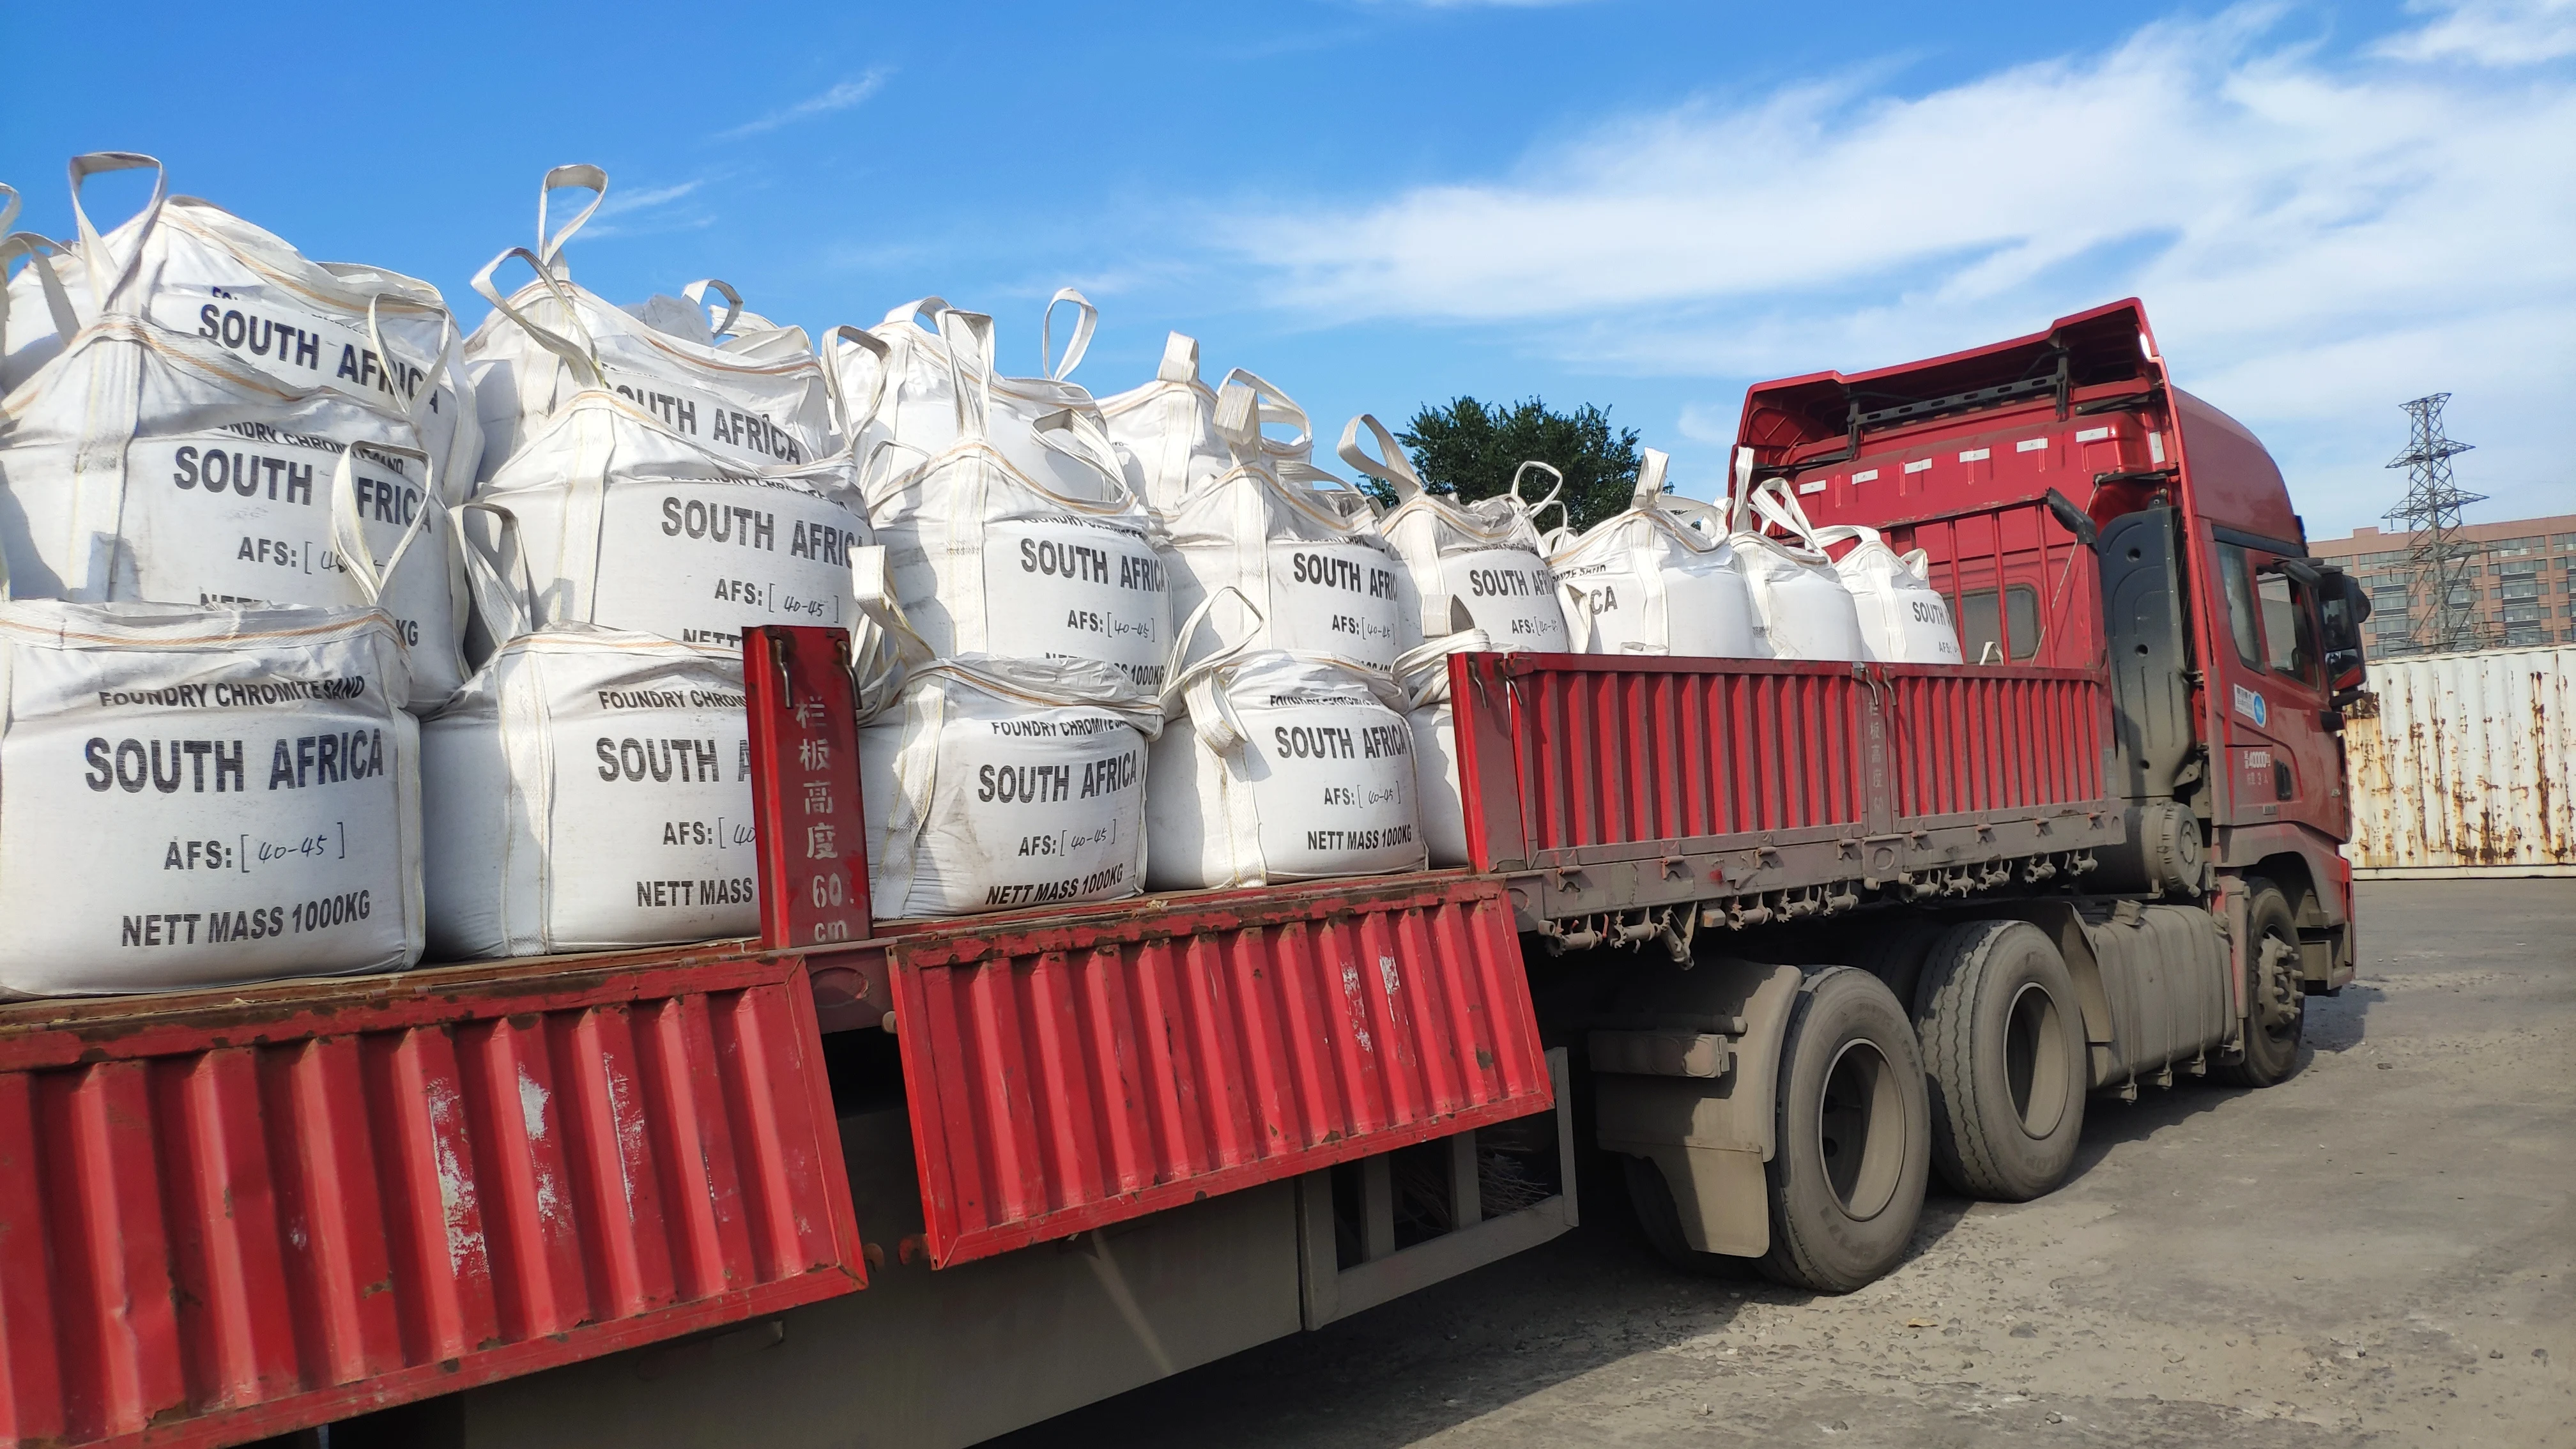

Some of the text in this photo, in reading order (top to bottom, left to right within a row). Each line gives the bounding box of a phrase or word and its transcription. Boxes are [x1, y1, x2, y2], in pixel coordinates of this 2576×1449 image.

[199, 304, 319, 371] SOUTH
[606, 382, 801, 465] UTH AFRICA
[174, 446, 432, 534] SOUTH FRICA
[662, 496, 864, 569] SOUTH AFRIC
[238, 537, 296, 567] AFS:
[1020, 538, 1166, 592] SOUTH AFRICA
[715, 578, 762, 606] AFS:
[1294, 553, 1398, 602] SOUTH AFRIC
[1469, 570, 1529, 597] SOUTH
[1067, 610, 1103, 633] AFS:
[1332, 614, 1360, 635] AFS:
[1512, 619, 1535, 634] AFS:
[1912, 601, 1946, 625] SOUTH
[99, 675, 365, 708] FOUNDRY CHROMITE SAND
[598, 690, 747, 710] FOUNDRY CHROM
[991, 721, 1057, 737] FOUNDRY
[1059, 717, 1114, 736] CHROMITE
[1275, 724, 1407, 759] SOUTH AFRICA
[86, 728, 384, 793] SOUTH AFRICA
[596, 737, 720, 783] SOUTH
[978, 749, 1137, 803] SOUTH AFRICA
[1324, 788, 1355, 805] AFS:
[663, 821, 712, 846] AFS:
[795, 694, 849, 942] 栏板高度 60 cm
[1018, 835, 1057, 857] AFS:
[1308, 824, 1412, 850] NETT MASS 1000KG
[164, 839, 232, 871] AFS:
[637, 877, 753, 907] NETT MASS
[985, 862, 1124, 905] NETT MASS 1000KG
[122, 889, 370, 947] NETT MASS 1000KG
